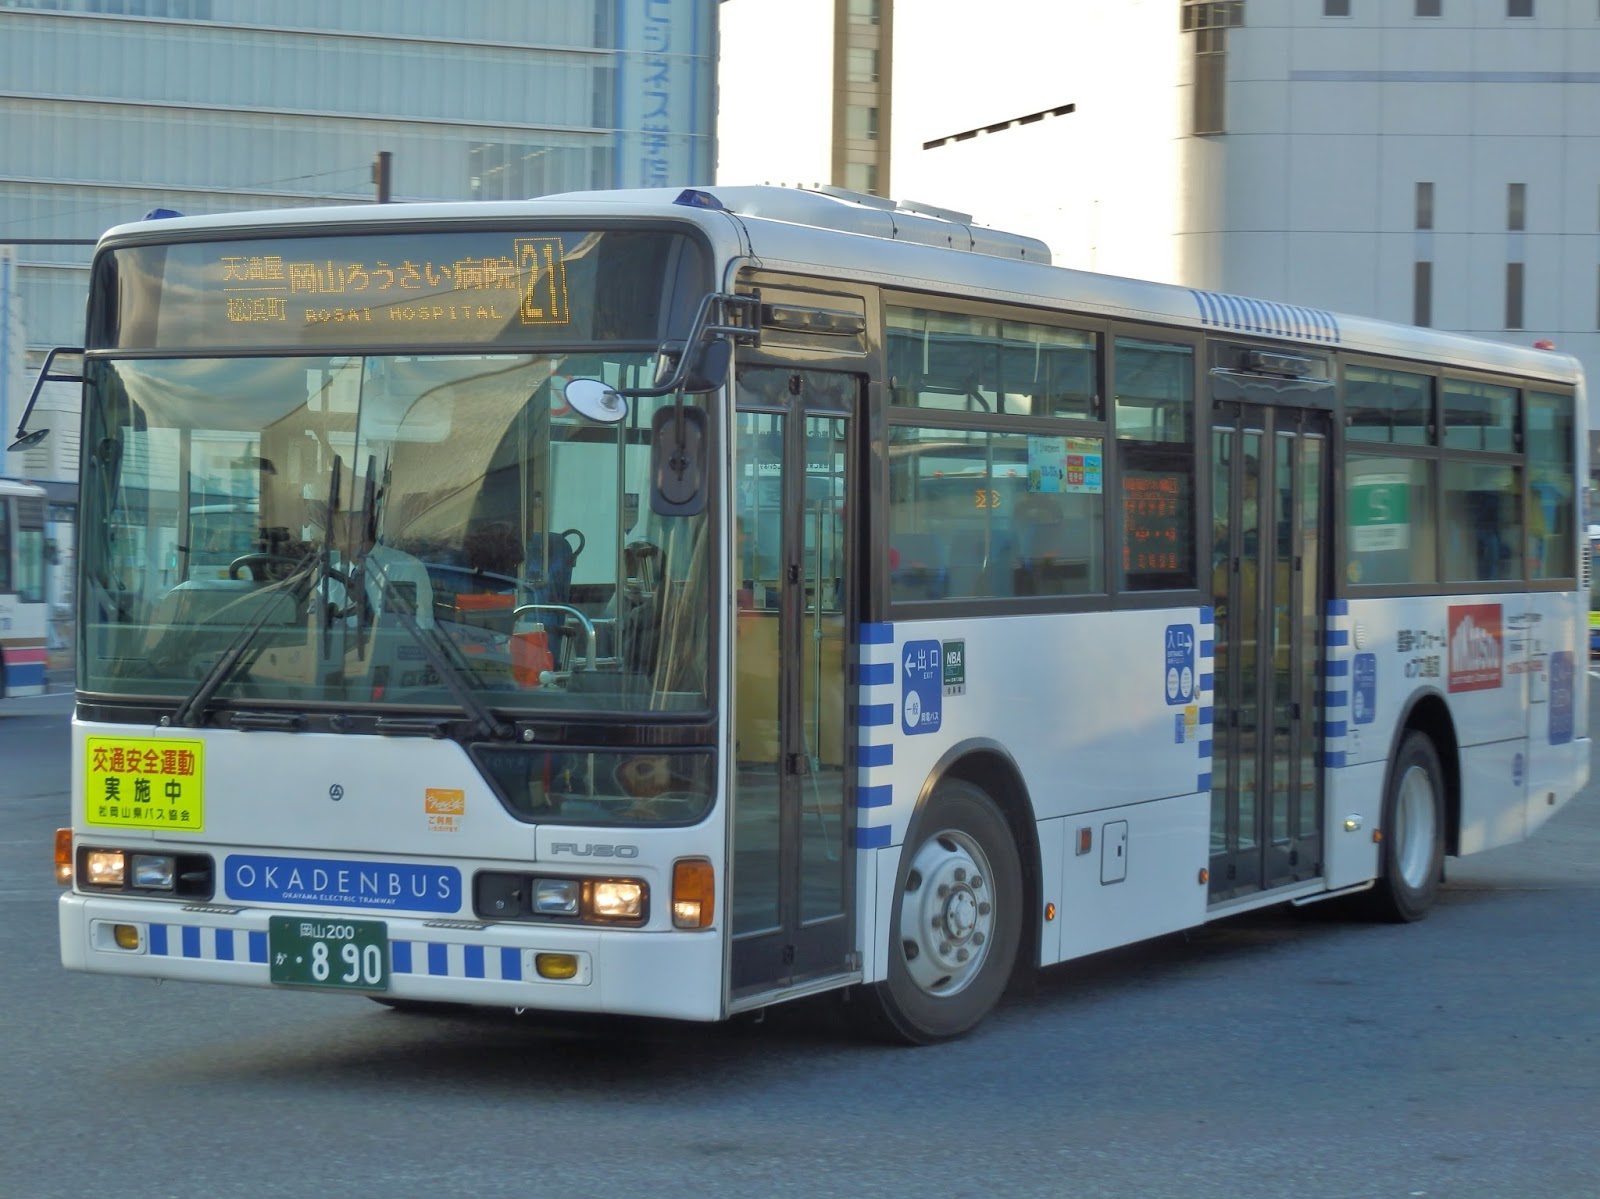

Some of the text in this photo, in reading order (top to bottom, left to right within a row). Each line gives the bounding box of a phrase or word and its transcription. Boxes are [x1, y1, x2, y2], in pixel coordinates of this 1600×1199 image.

[221, 256, 285, 281] 天満屋
[289, 256, 516, 293] 岡山ろうさい病院
[522, 244, 558, 317] 21
[305, 305, 503, 322] ROSAI HOSPITAL
[917, 649, 938, 671] 出口
[946, 651, 962, 665] NBA
[923, 671, 934, 680] EXIT
[93, 747, 194, 776] 交通安全運動
[104, 776, 182, 805] 実施中
[551, 842, 639, 858] FUSO
[282, 891, 397, 905] OKAYAMA ELECTRIC TRAMWAY
